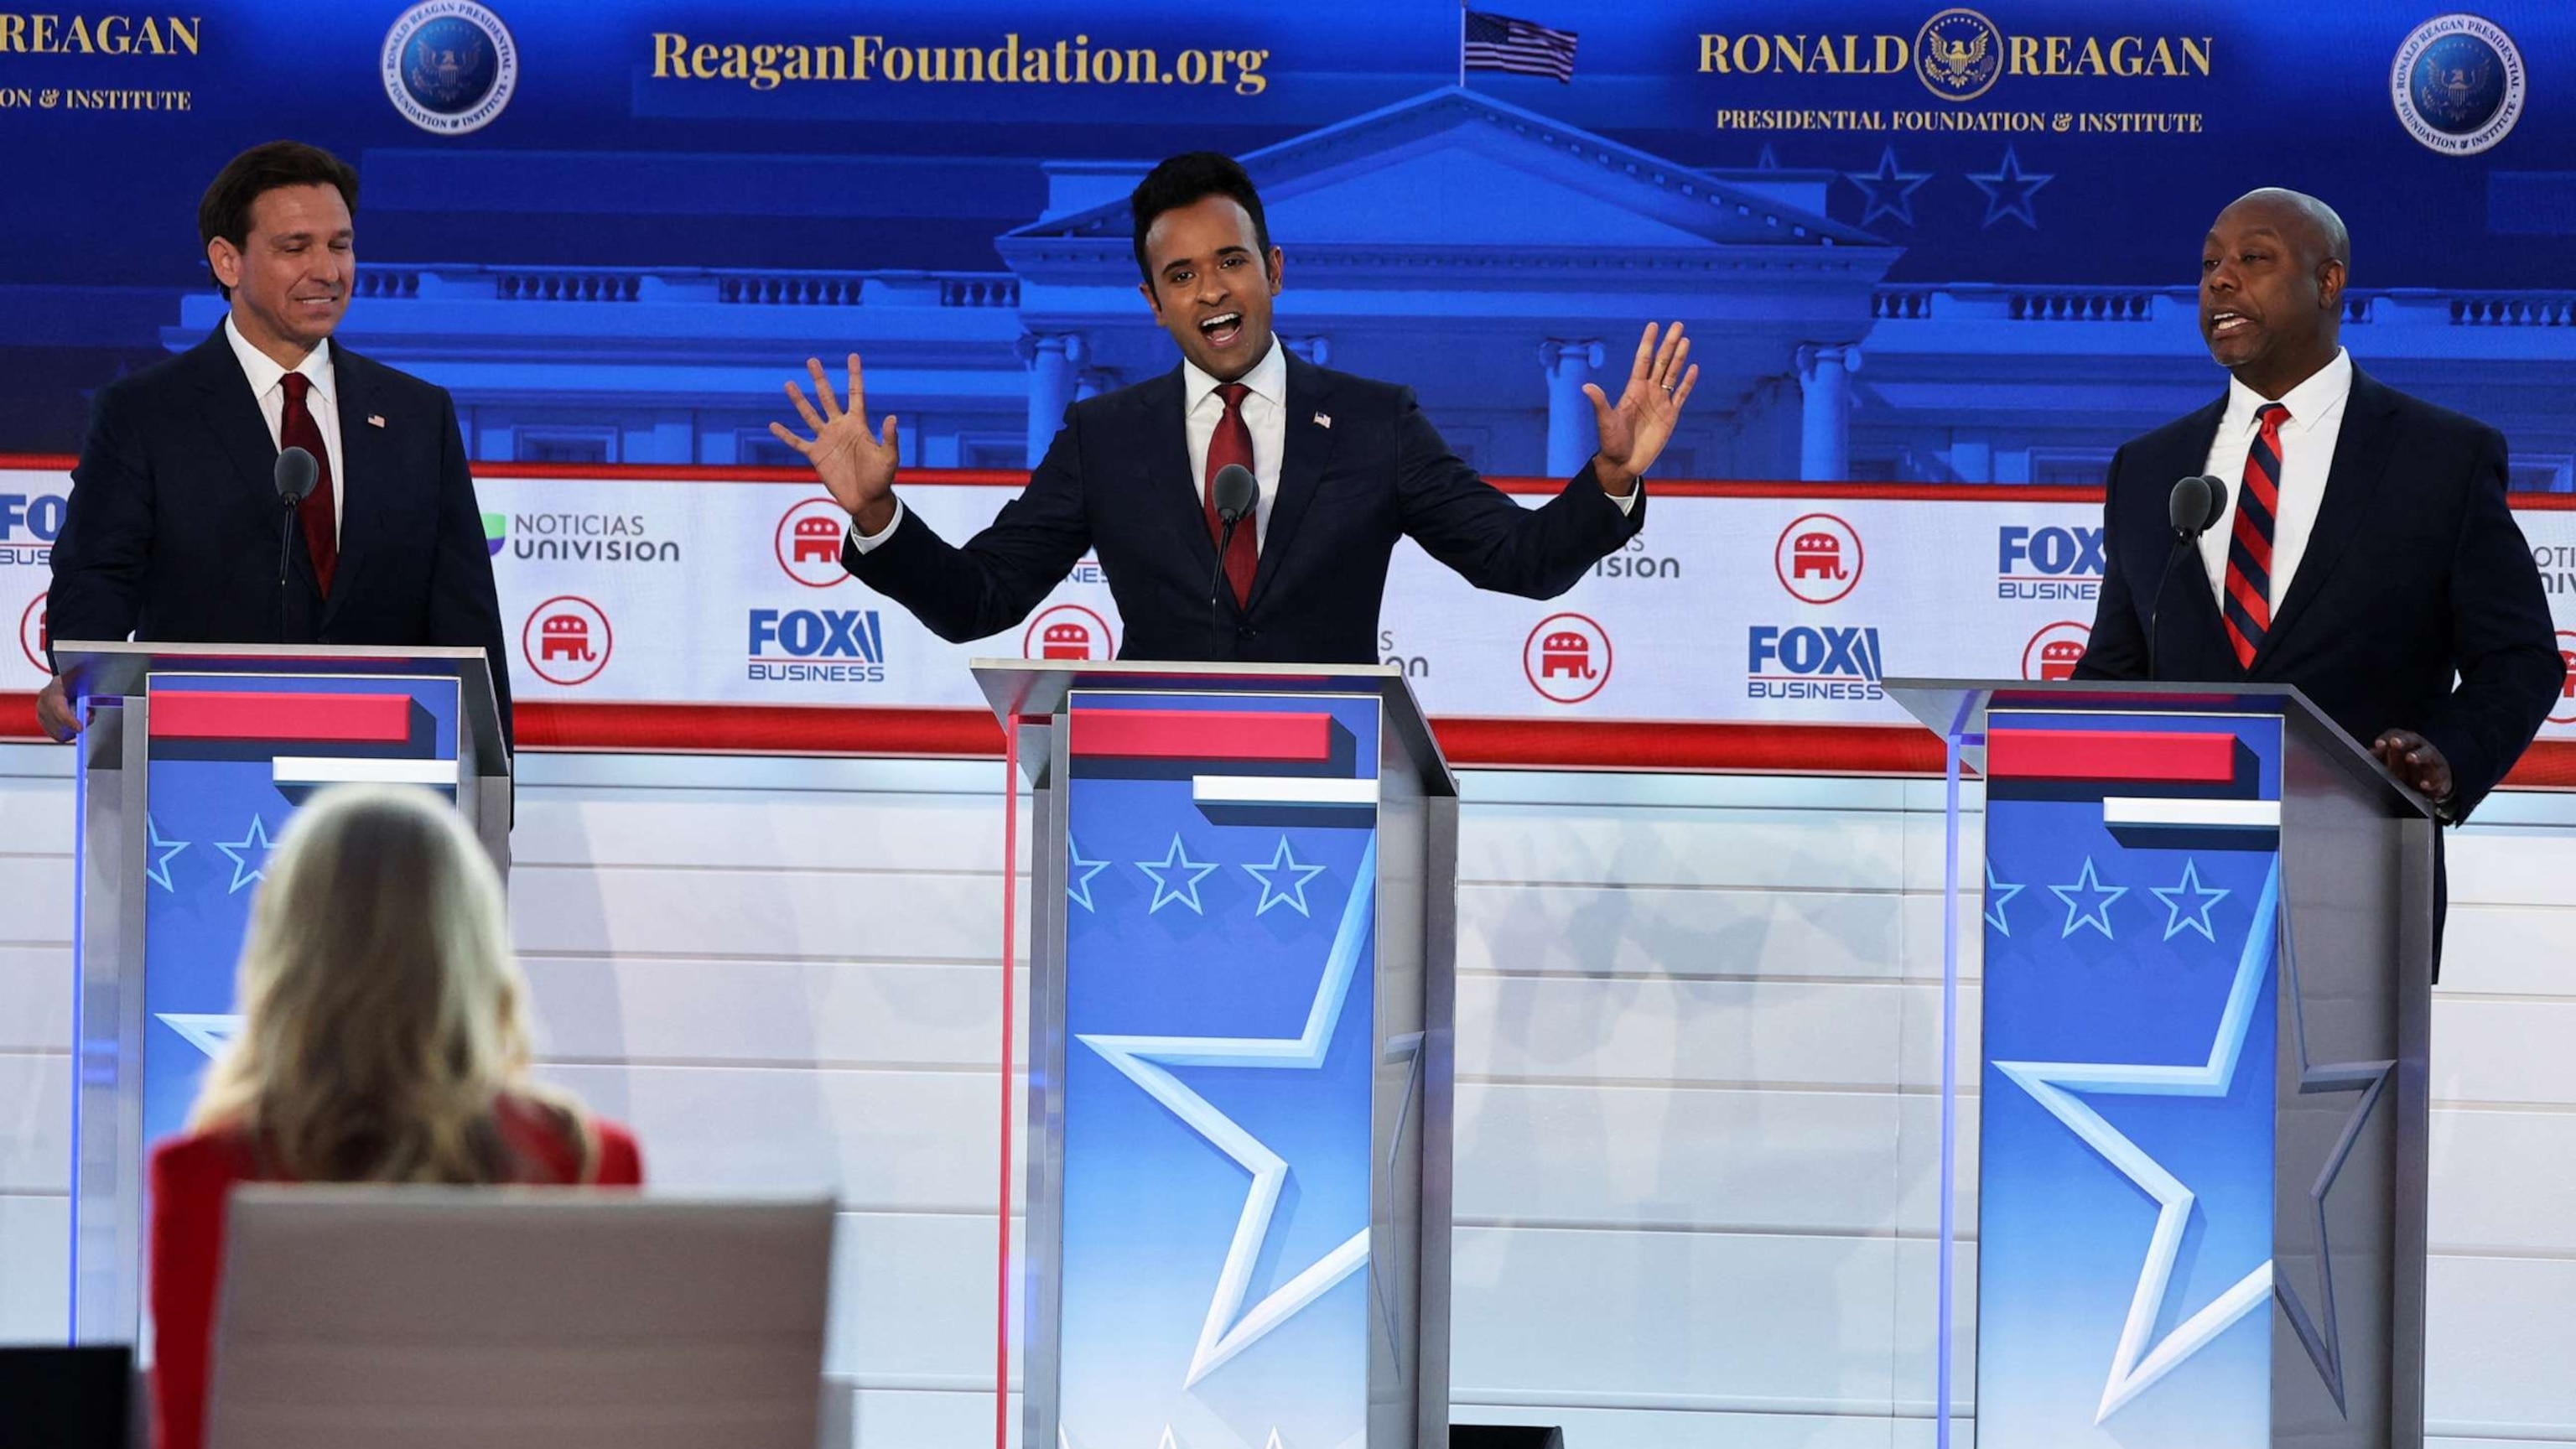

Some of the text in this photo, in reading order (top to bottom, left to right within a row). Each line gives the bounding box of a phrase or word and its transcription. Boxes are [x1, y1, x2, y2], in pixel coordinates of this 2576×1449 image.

[0, 14, 201, 55] REAGAN
[387, 3, 511, 70] RONALD REAGAN PRESIDENTIAL
[1697, 34, 2213, 76] RONALD REAGAN
[2397, 19, 2520, 89] RONALD REAGAN PRESIDENTIAL
[652, 33, 1269, 95] ReaganFoundation.org
[39, 88, 60, 108] &
[65, 89, 191, 111] INSTITUTE
[390, 82, 447, 128] FOUNDATION
[462, 84, 507, 126] INSTITUTE
[1717, 110, 2202, 132] PRESIDENTIAL FOUNDATION & INSTITUTE
[2400, 101, 2456, 148] FOUNDATION
[2472, 102, 2516, 147] INSTITUTE
[0, 495, 68, 541] FO
[516, 514, 644, 536] NOTICIAS
[1999, 527, 2105, 574] FOX
[1999, 583, 2098, 600] BUSINE
[749, 610, 861, 657] FOX
[1749, 626, 1861, 674] FOX
[749, 664, 884, 682] BUSINESS
[1748, 682, 1883, 699] BUSINESS
